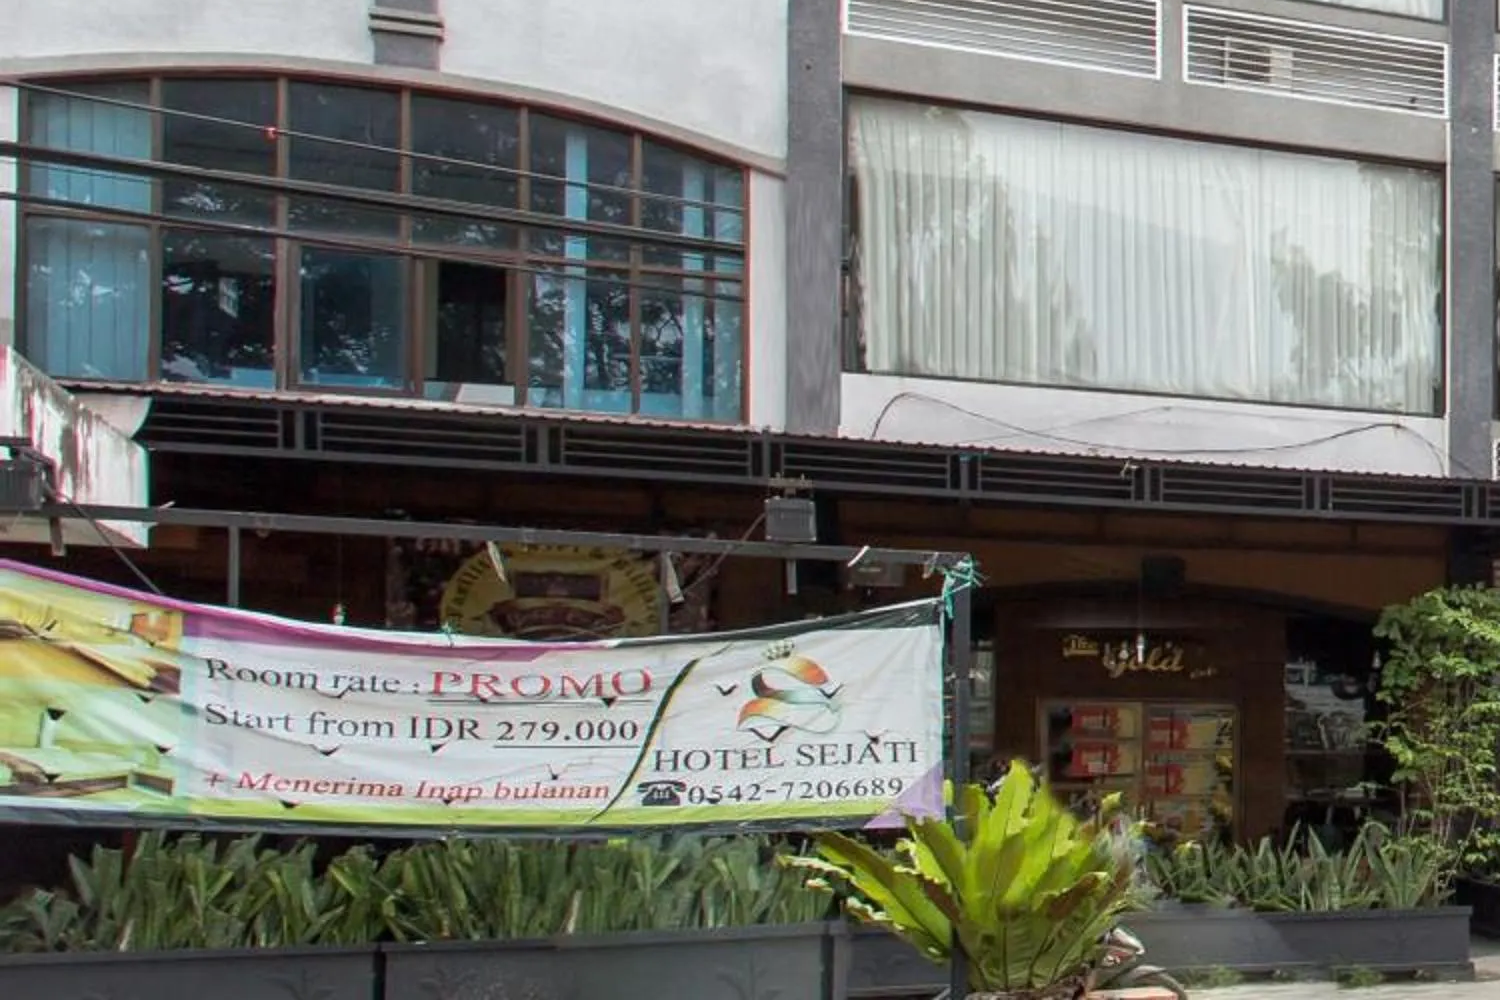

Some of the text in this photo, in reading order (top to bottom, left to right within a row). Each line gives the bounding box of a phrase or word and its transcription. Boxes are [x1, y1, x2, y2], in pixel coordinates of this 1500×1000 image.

[205, 657, 318, 691] Room
[431, 668, 653, 698] PROMO
[204, 702, 639, 742] Start from IDR 279.000
[654, 740, 918, 773] HOTEL SEJATI
[236, 771, 403, 798] Menerima
[416, 780, 482, 803] Inap
[493, 779, 610, 800] bulanan
[687, 777, 904, 805] 0542-7206689
